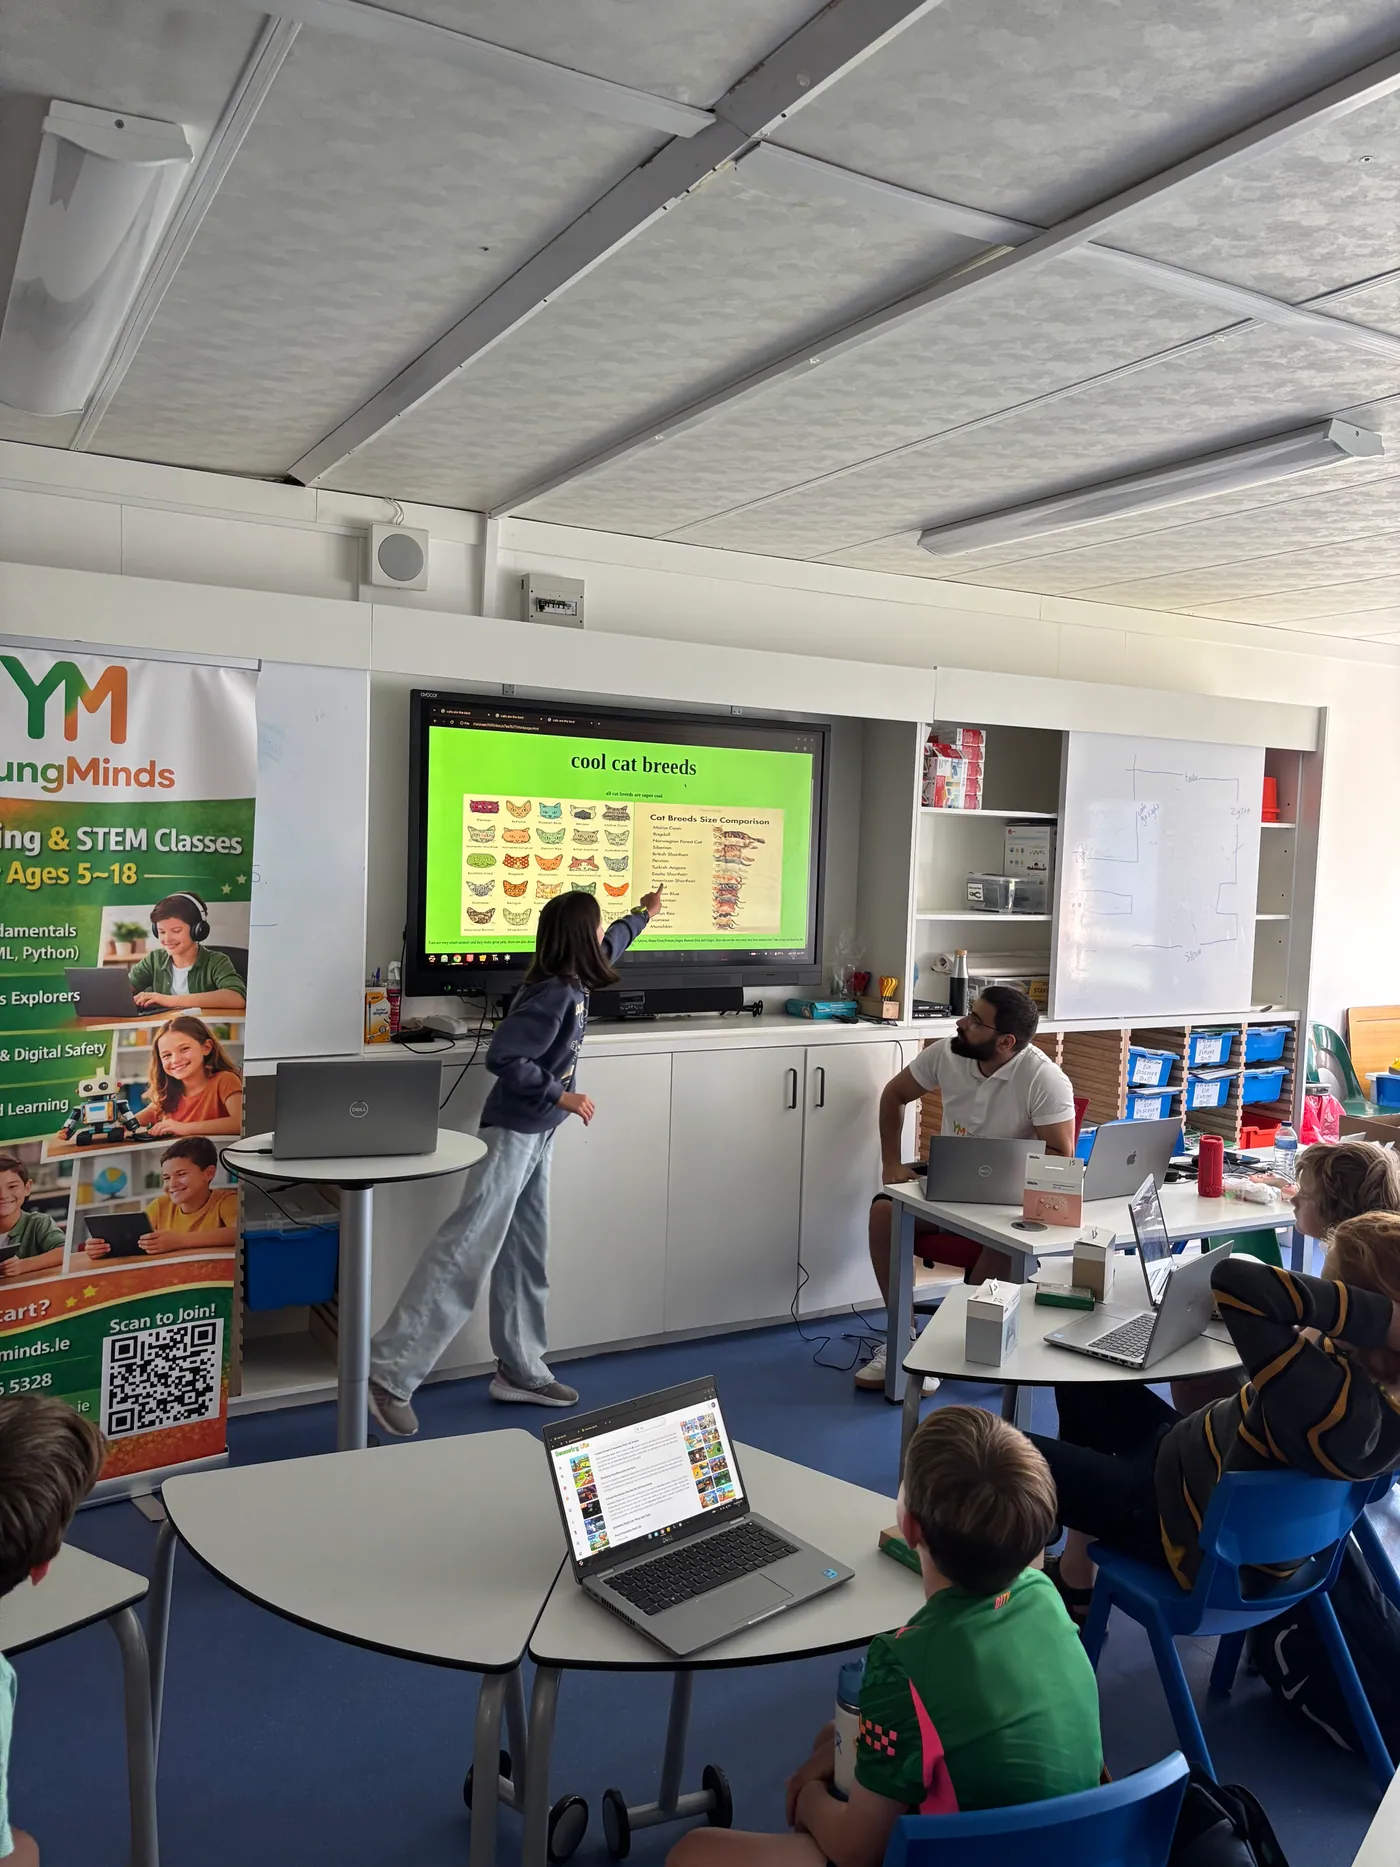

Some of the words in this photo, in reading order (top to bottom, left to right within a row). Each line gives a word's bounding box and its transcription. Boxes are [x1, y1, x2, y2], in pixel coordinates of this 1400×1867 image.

[0, 656, 128, 744] YM
[571, 753, 607, 770] cool
[611, 758, 638, 772] cat
[642, 756, 697, 776] breeds
[668, 814, 698, 823] Breeds
[700, 815, 718, 823] Size
[719, 816, 770, 826] Comparison
[48, 827, 70, 851] &
[77, 827, 147, 851] STEM
[155, 829, 243, 854] Classes
[6, 861, 69, 890] Ages
[23, 946, 79, 962] Python)
[11, 990, 80, 1007] Explorers
[14, 1044, 61, 1063] Digital
[64, 1042, 107, 1057] Safety
[8, 1098, 69, 1116] Learning
[109, 1315, 151, 1333] Scan
[156, 1311, 173, 1324] to
[177, 1303, 216, 1324] Join!
[9, 1373, 53, 1394] 5328
